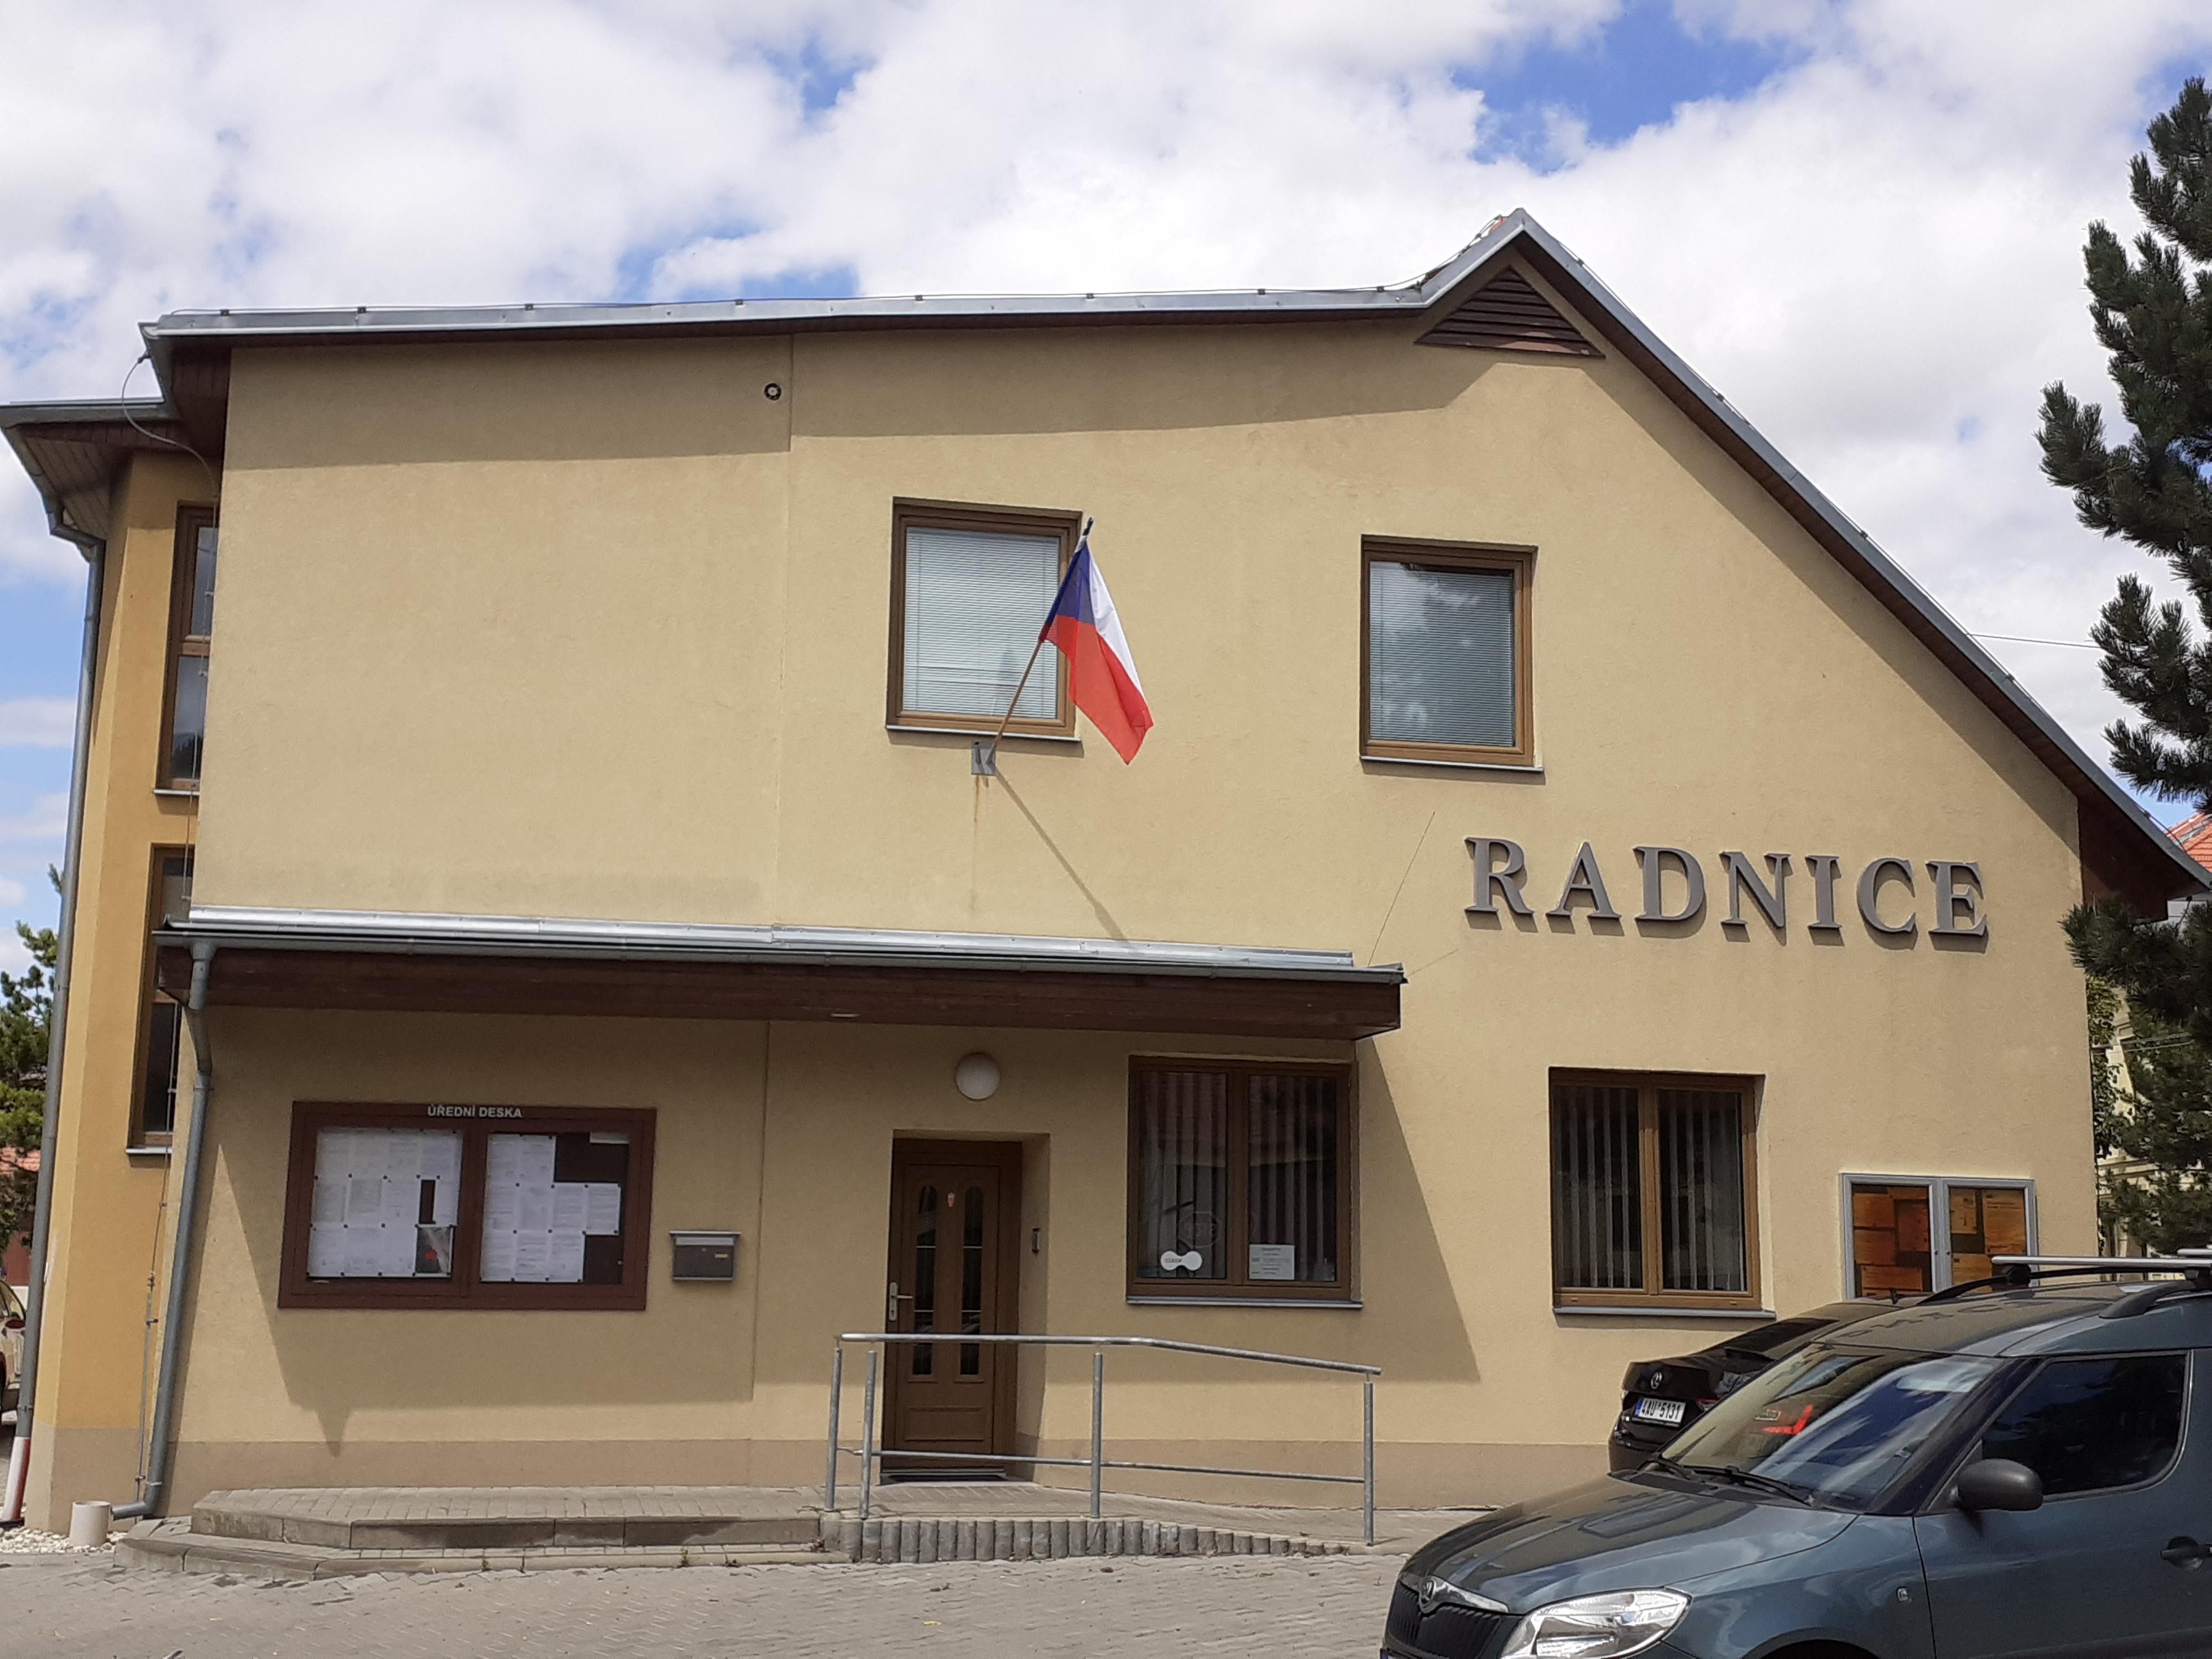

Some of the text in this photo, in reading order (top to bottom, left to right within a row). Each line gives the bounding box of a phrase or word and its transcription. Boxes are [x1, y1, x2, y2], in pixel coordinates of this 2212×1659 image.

[1464, 837, 1989, 937] RADNICE
[427, 1104, 523, 1118] ÚŘEDNÍ DESKA
[1660, 1402, 1681, 1420] 5131
